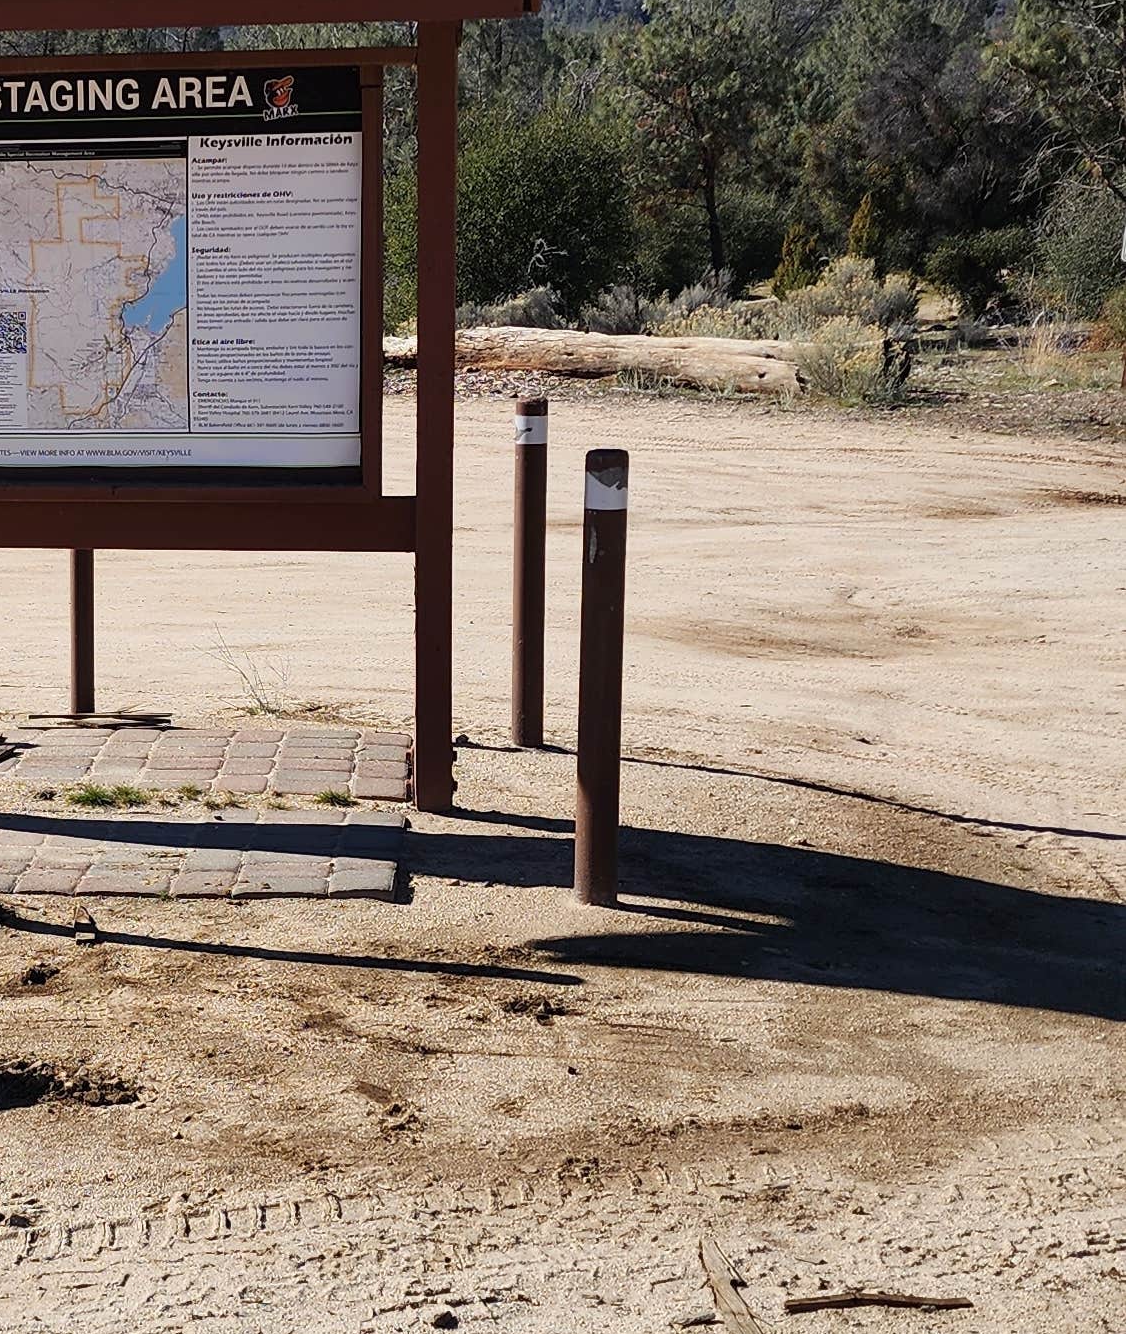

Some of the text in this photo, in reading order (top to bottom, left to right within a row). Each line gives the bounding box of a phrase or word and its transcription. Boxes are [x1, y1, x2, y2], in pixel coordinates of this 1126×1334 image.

[151, 75, 254, 110] AREA
[263, 104, 299, 122] MARX
[200, 134, 353, 150] Keysville Información
[192, 247, 231, 255] Seguridad:
